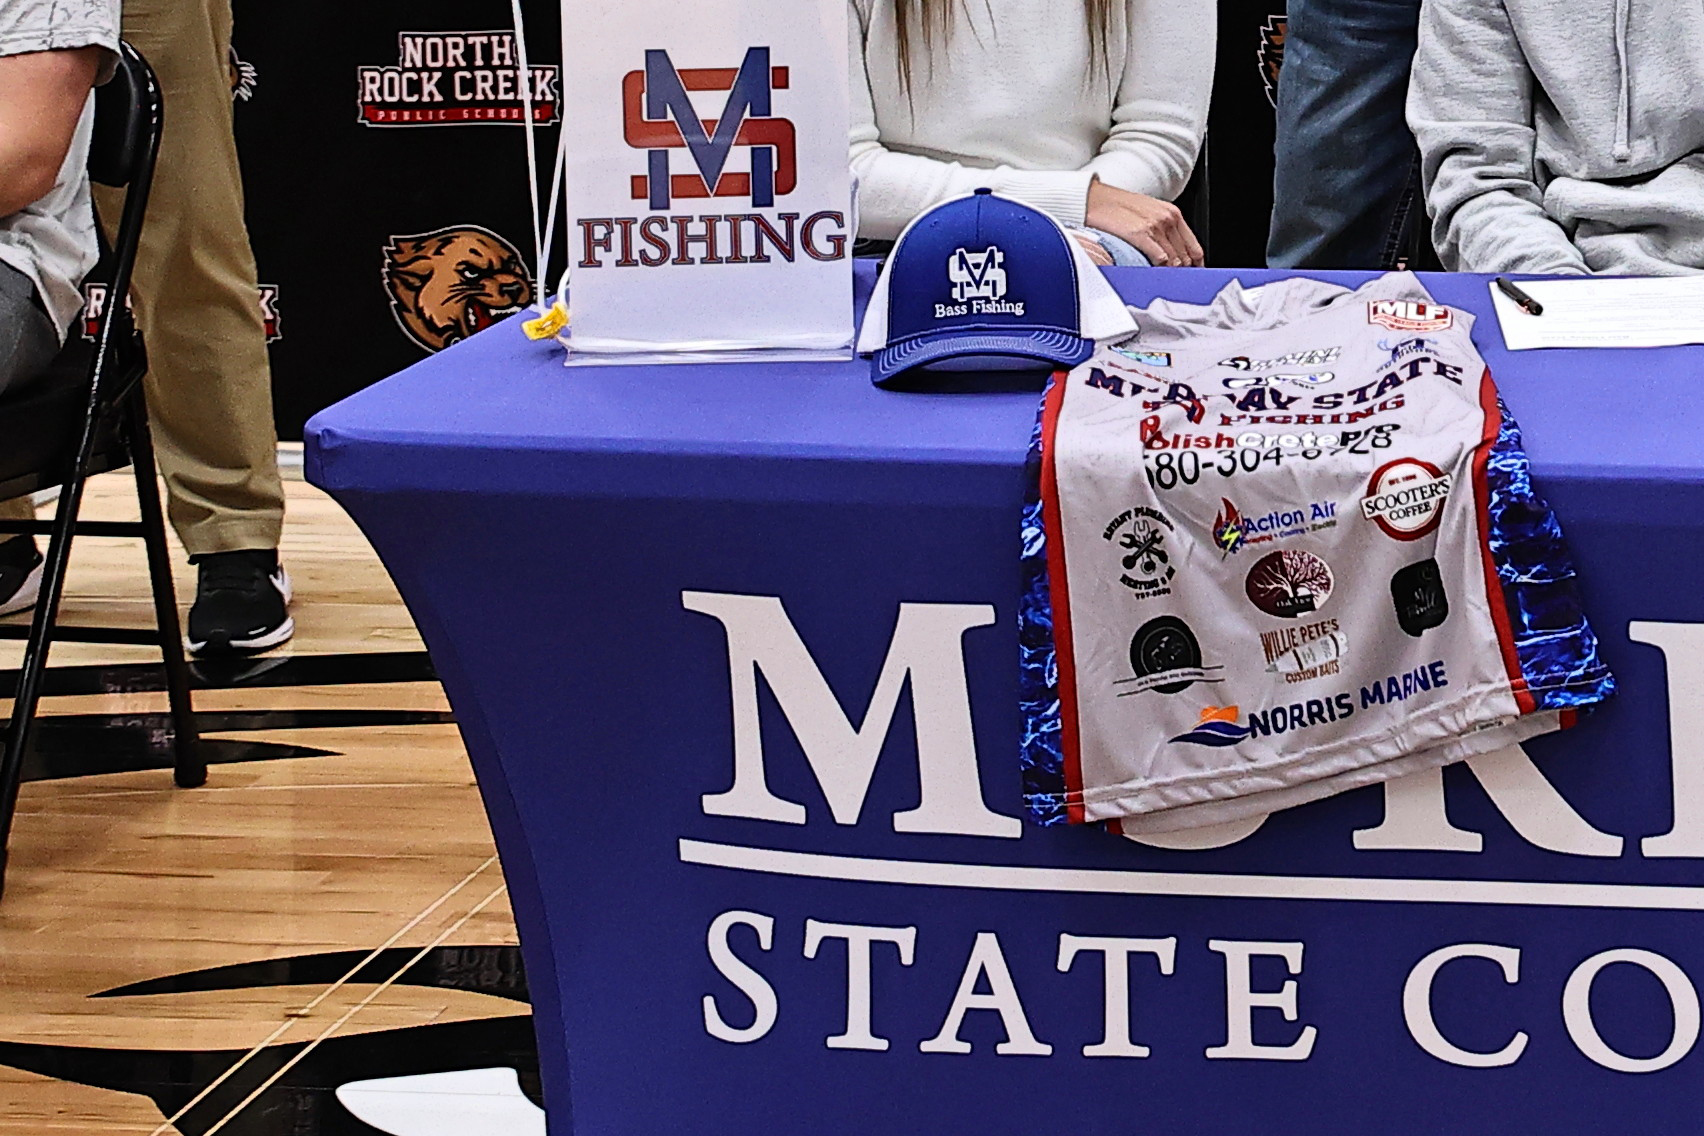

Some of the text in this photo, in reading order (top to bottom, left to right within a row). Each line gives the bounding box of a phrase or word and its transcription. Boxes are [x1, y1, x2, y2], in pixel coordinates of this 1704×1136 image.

[404, 35, 512, 68] NORTH
[363, 71, 444, 103] ROCK
[377, 110, 446, 121] PUBLIC
[577, 210, 848, 268] FISHING
[935, 299, 1025, 318] Bass Fishing
[1377, 300, 1447, 321] MLF
[1313, 357, 1463, 410] STATE
[1365, 478, 1451, 515] SCOOTER'S
[1389, 501, 1432, 521] COFFEE
[1243, 501, 1337, 536] Action Air
[1260, 627, 1300, 665] WILLIE
[1300, 619, 1339, 644] PETE'S
[1285, 659, 1340, 684] CUSTOM BAITS
[1248, 692, 1354, 739] NORRIS
[703, 909, 1318, 1062] STATE
